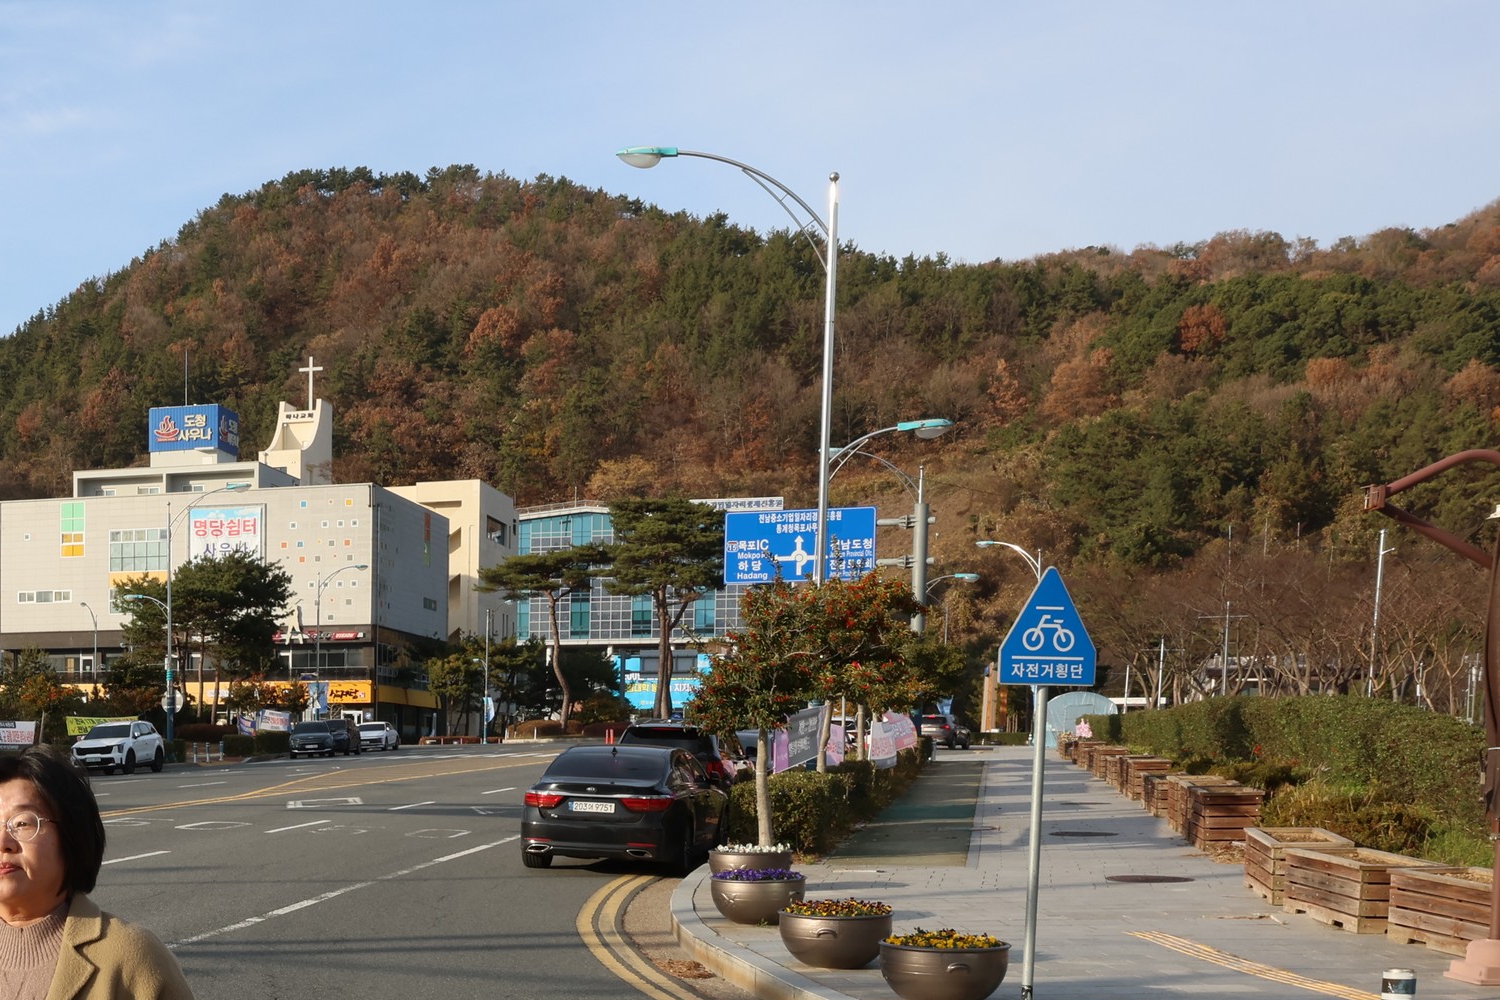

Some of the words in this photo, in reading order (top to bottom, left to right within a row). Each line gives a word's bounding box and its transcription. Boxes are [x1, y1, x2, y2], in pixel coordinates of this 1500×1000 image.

[184, 414, 208, 427] 도청
[178, 427, 213, 442] 사우나
[194, 517, 257, 537] 명당쉼터
[776, 522, 818, 534] 통계청목포사무
[739, 539, 769, 551] 목포IC
[737, 552, 761, 560] Mokpo
[737, 572, 768, 581] Hadang
[1011, 662, 1083, 679] 자전거횡단
